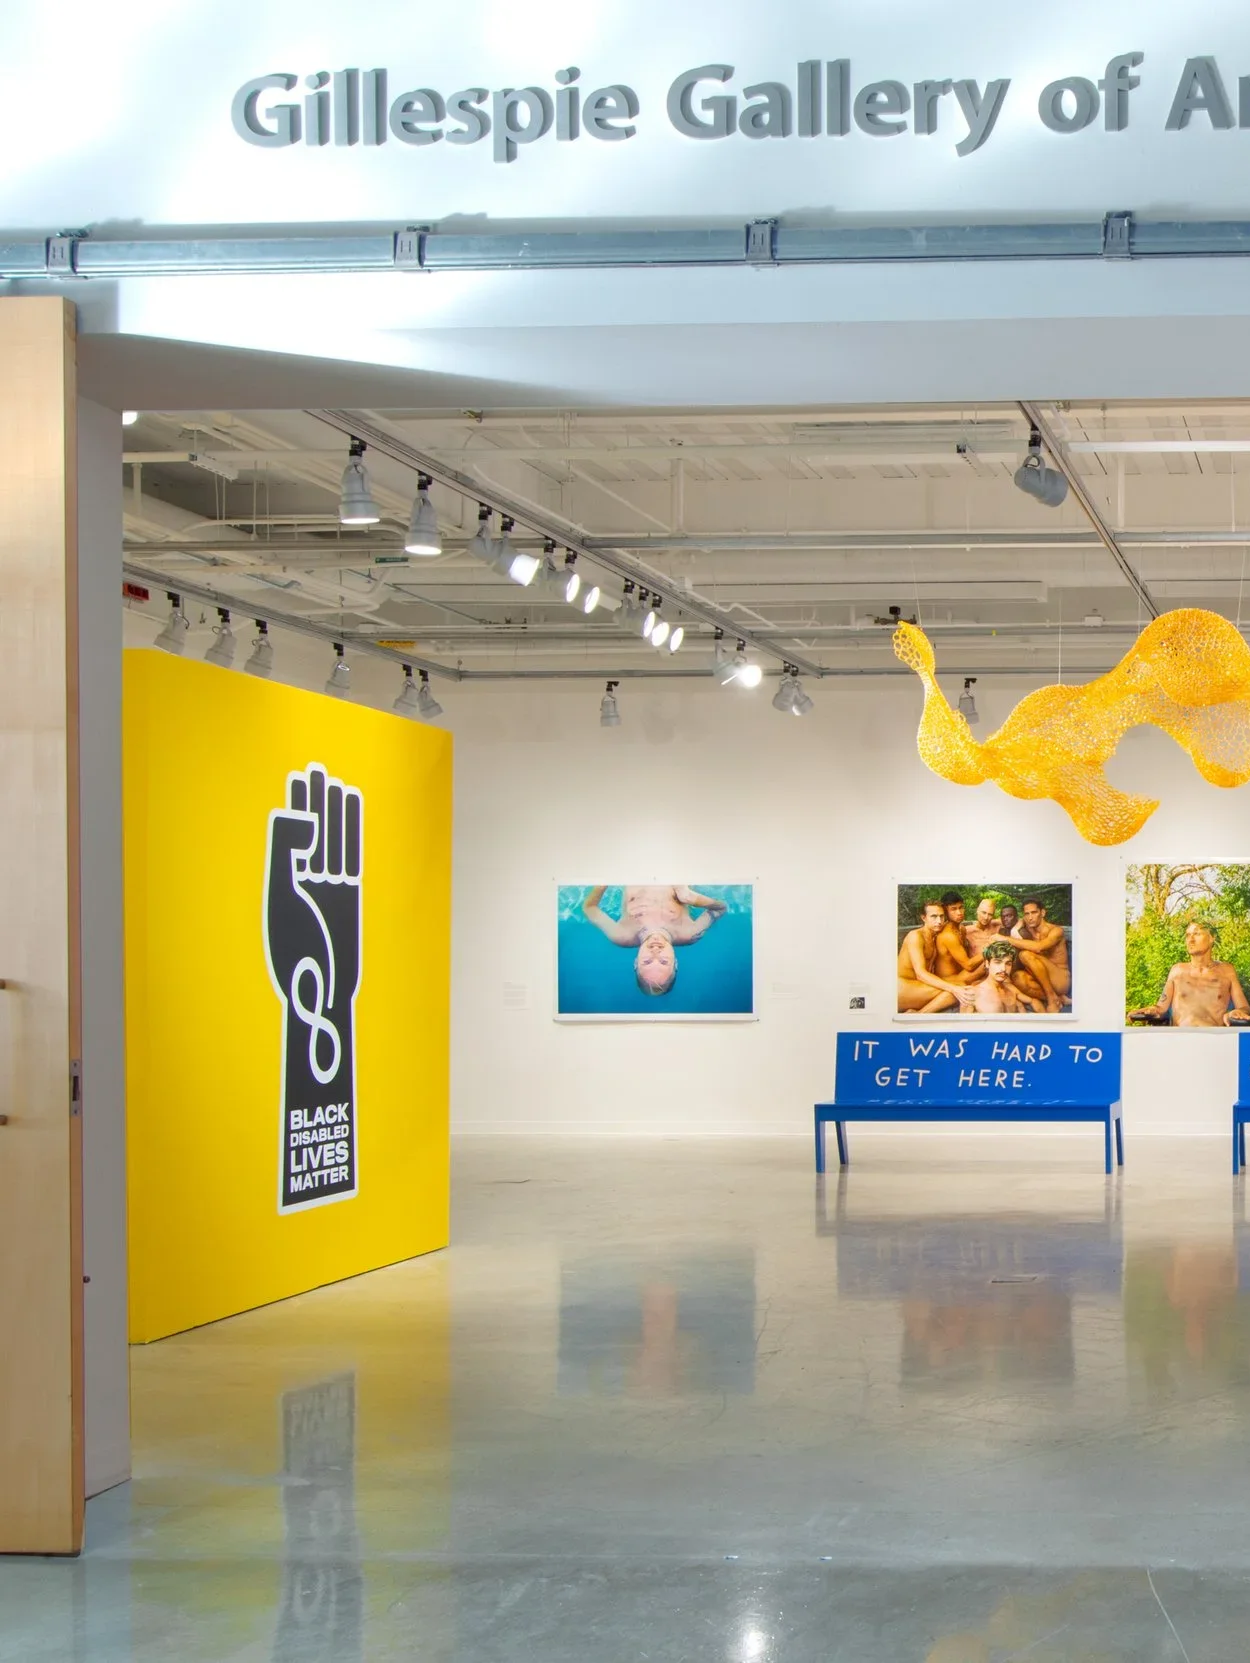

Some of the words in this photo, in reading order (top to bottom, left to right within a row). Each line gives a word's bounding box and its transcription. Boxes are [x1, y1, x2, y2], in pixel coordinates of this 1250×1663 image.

[230, 66, 640, 163] Gillespie
[665, 59, 1012, 157] Gallery
[1038, 51, 1144, 133] of
[853, 1040, 880, 1061] IT
[908, 1037, 969, 1059] WAS
[991, 1041, 1052, 1063] HARD
[1068, 1045, 1103, 1064] TO
[875, 1066, 931, 1088] GET
[958, 1069, 1033, 1089] HERE.
[290, 1102, 350, 1131] BLACK
[290, 1124, 350, 1147] DISABLED
[290, 1140, 350, 1174] LIVES
[290, 1165, 350, 1193] MATTER
